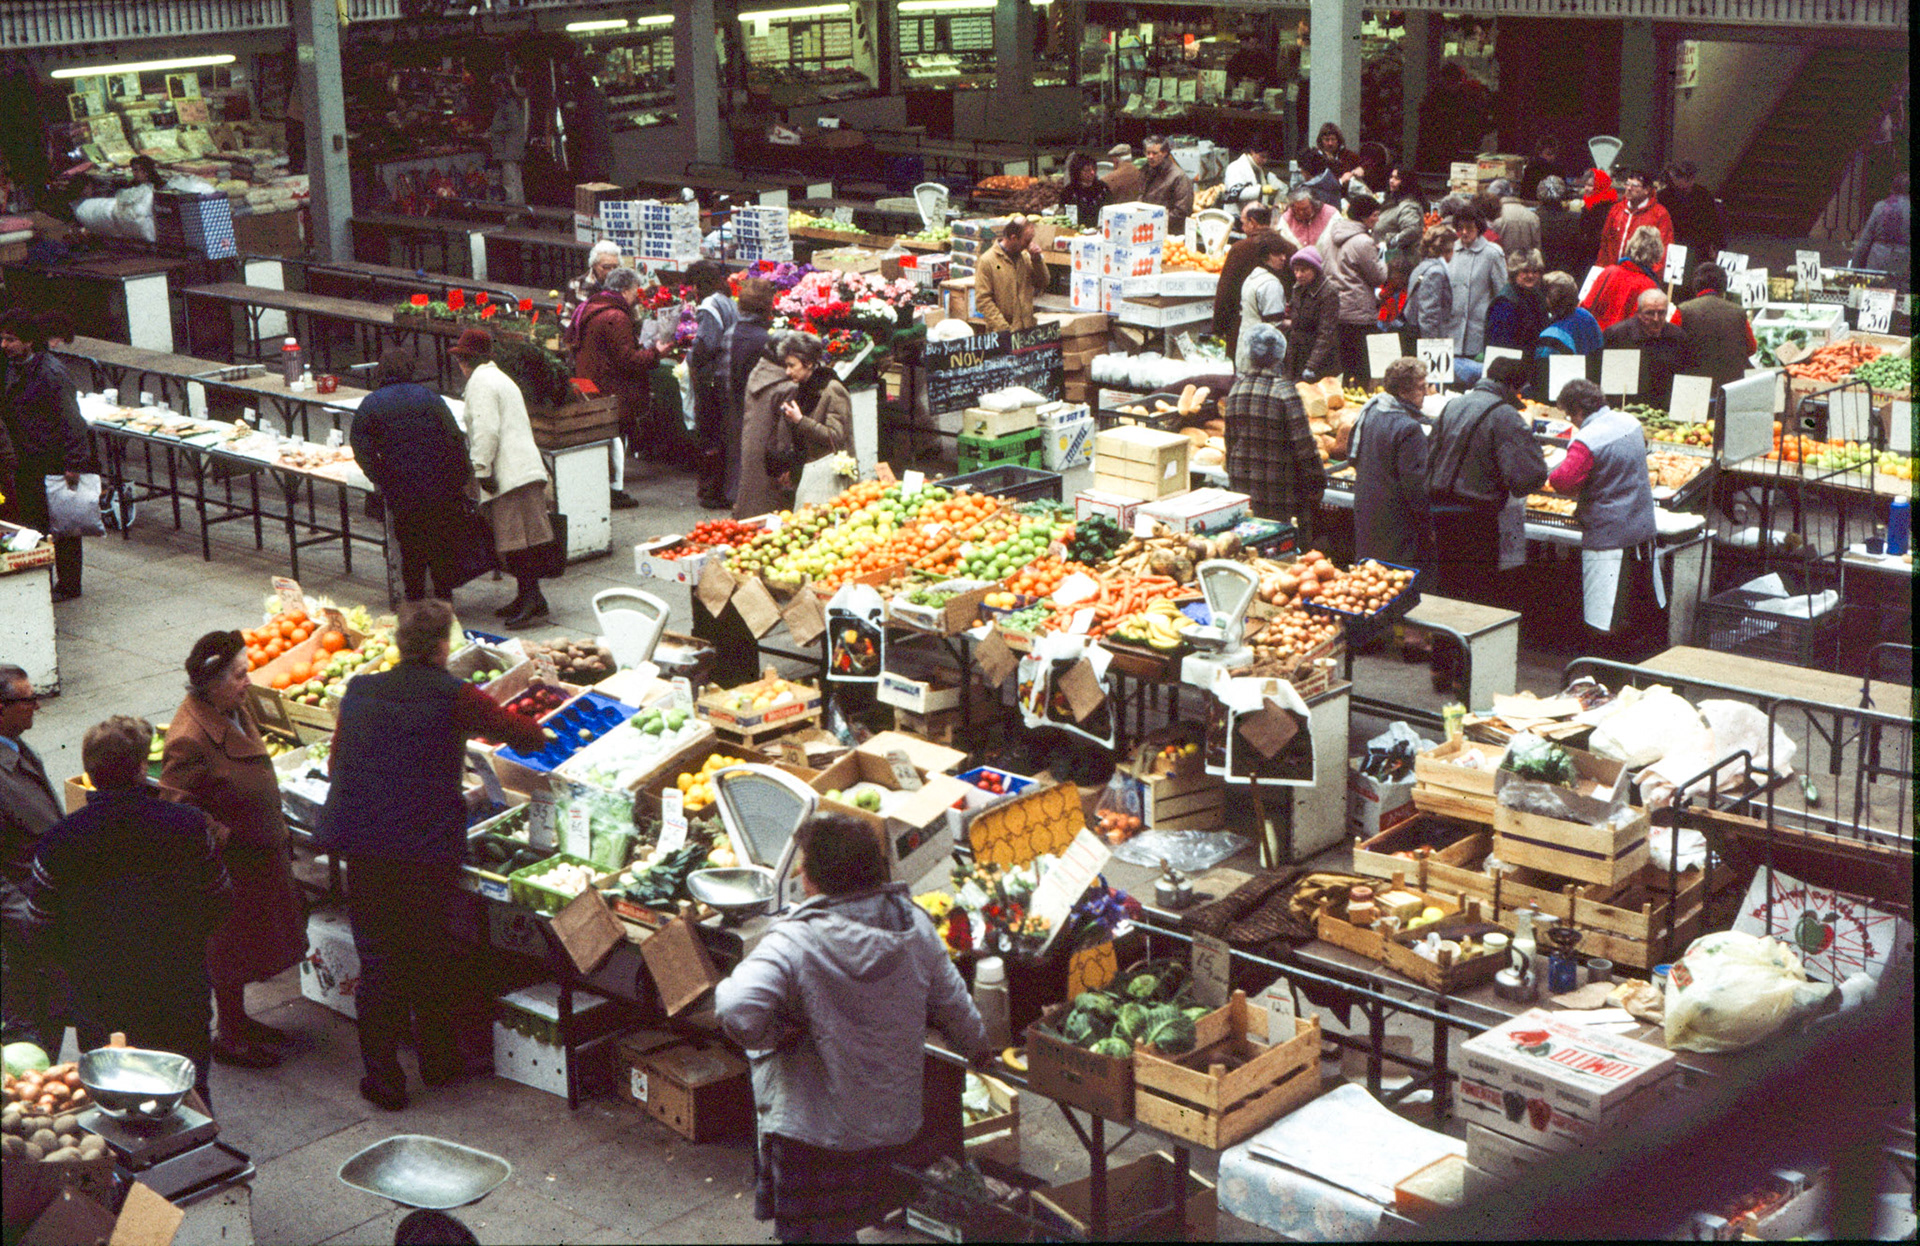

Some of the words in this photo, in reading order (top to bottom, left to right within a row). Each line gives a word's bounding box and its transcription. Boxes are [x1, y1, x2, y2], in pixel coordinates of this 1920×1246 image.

[1801, 261, 1818, 281] 30
[950, 350, 985, 368] NOW
[1423, 350, 1450, 374] 30
